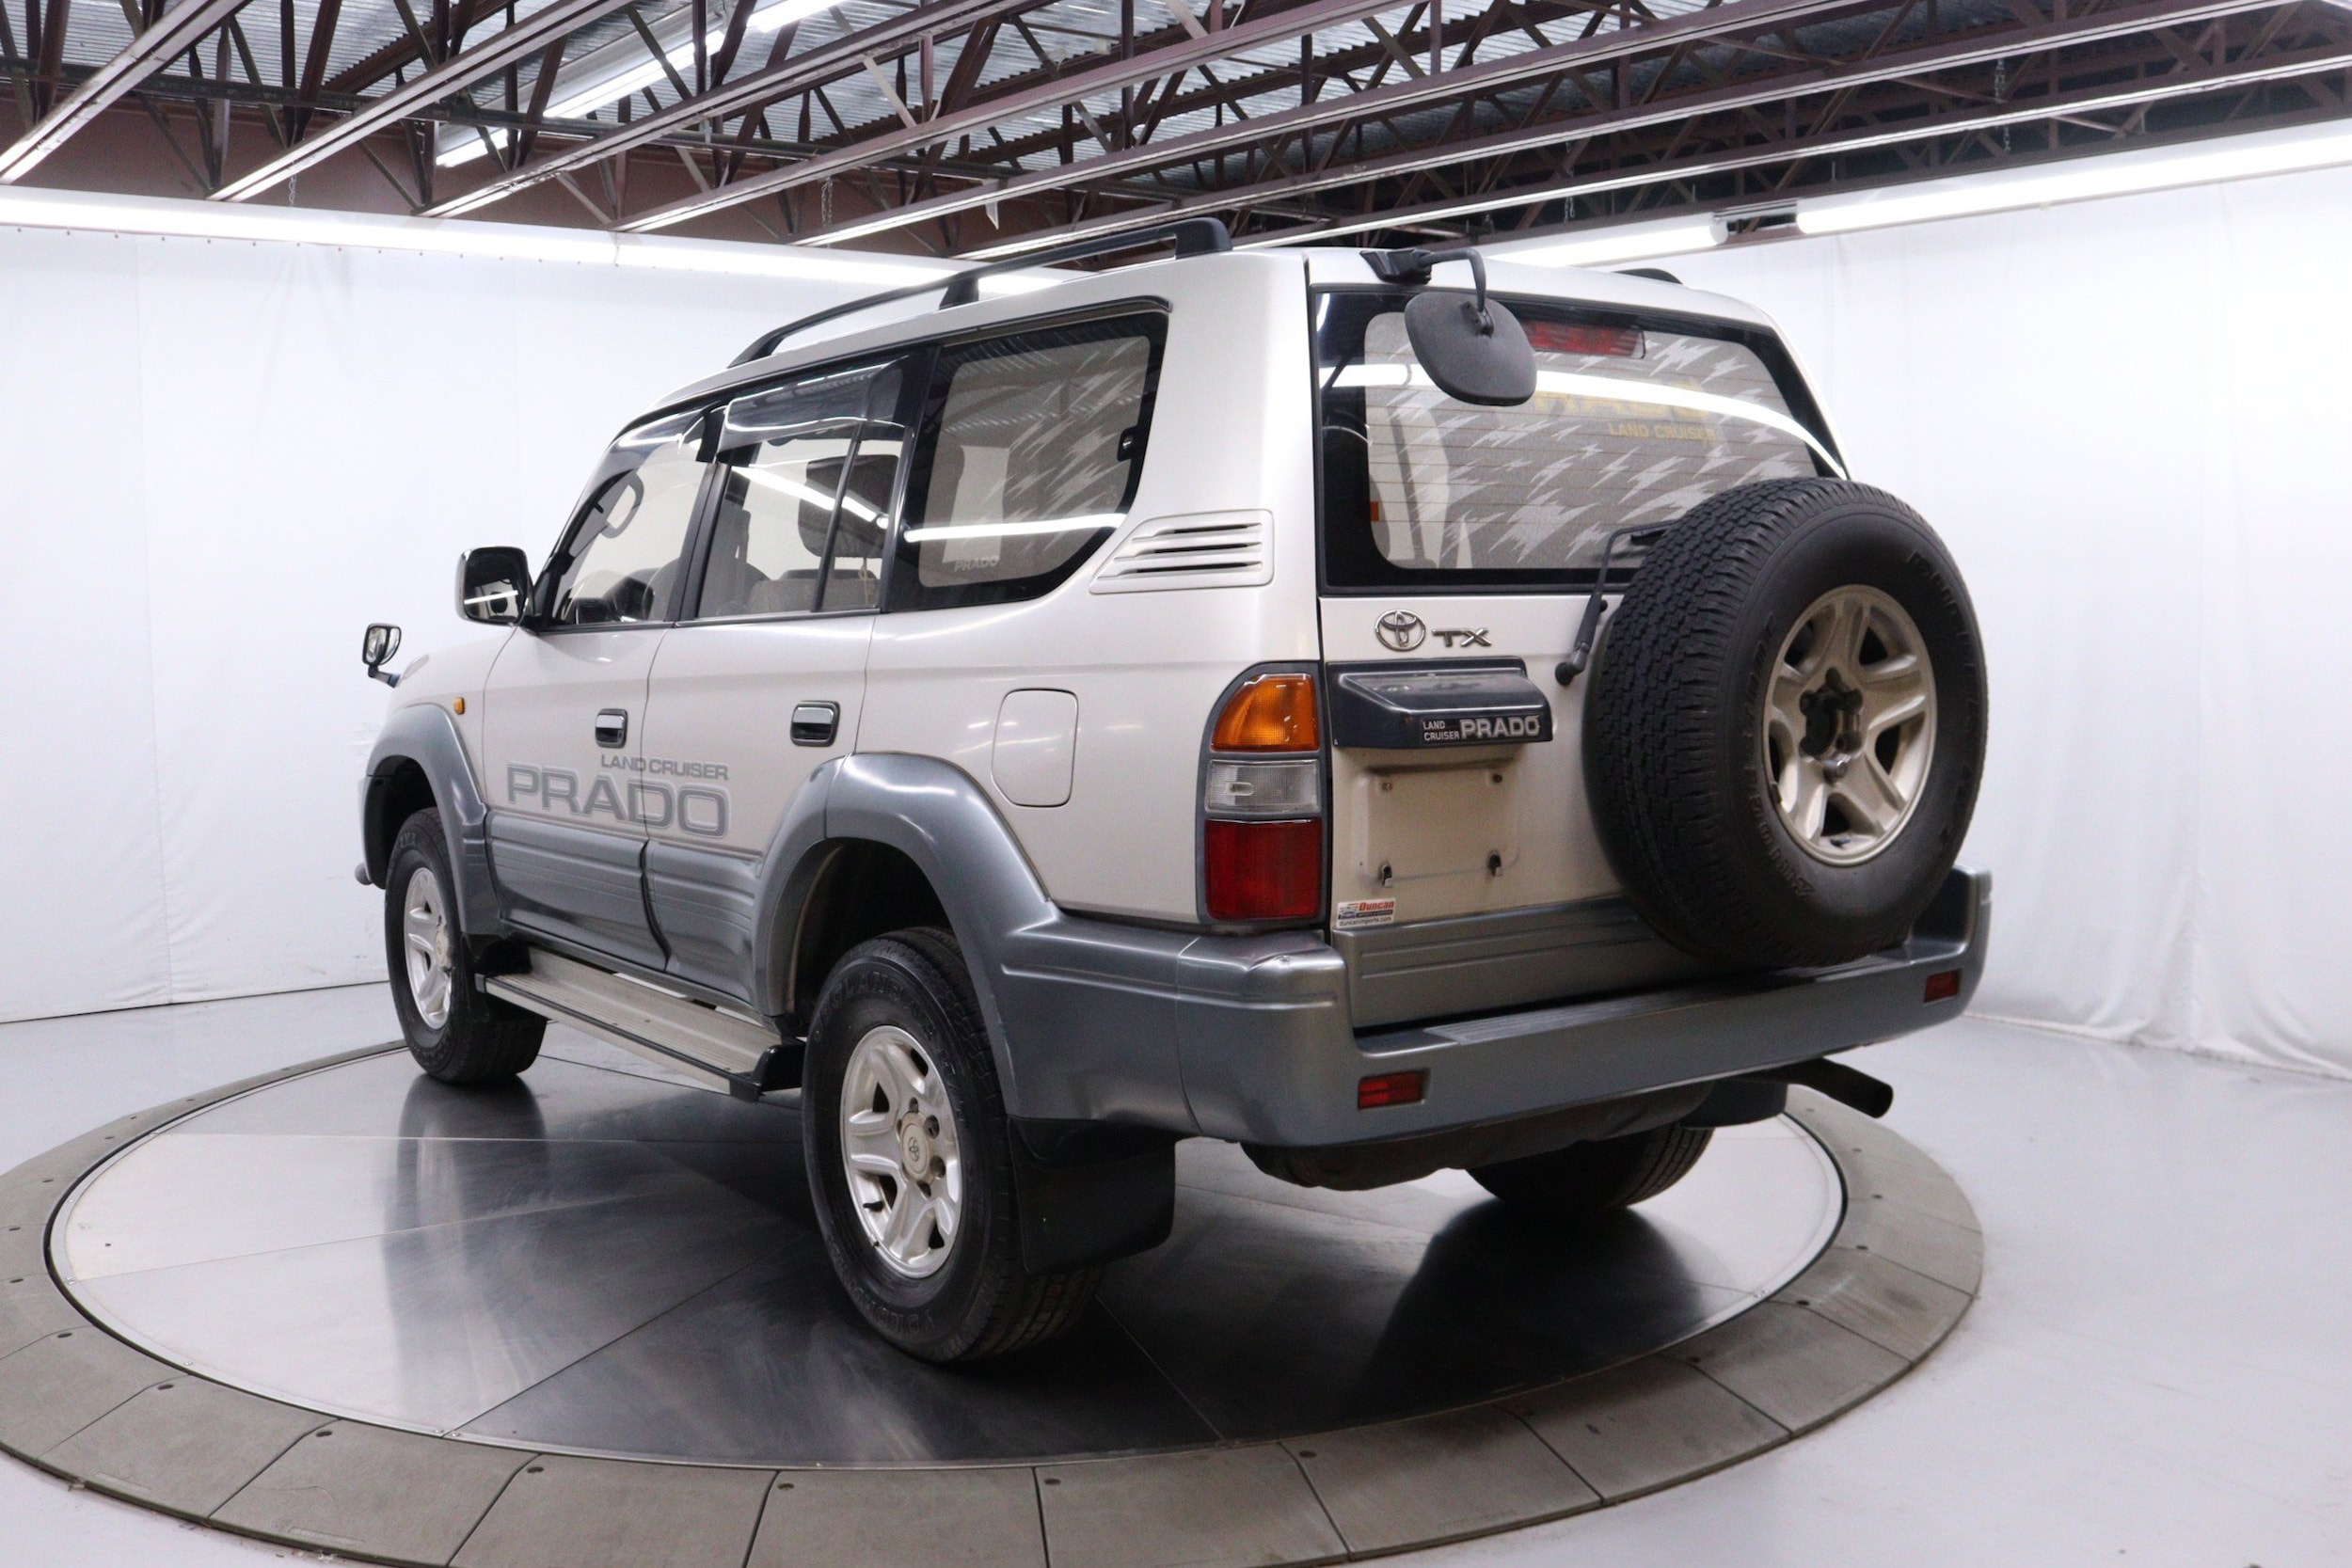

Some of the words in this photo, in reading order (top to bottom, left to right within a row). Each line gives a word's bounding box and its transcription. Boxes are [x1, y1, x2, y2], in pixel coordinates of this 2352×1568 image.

[1608, 423, 1649, 437] LAND
[1654, 424, 1715, 440] CRUISER
[954, 554, 1000, 573] PRADO
[1432, 627, 1492, 647] TX
[1422, 721, 1446, 730] LAND
[1460, 715, 1541, 739] PRADO
[1423, 731, 1459, 741] CRUISER
[601, 753, 646, 773] LAND
[650, 757, 729, 781] CRUISER
[506, 762, 731, 839] PRADO
[1359, 901, 1394, 911] Duncan
